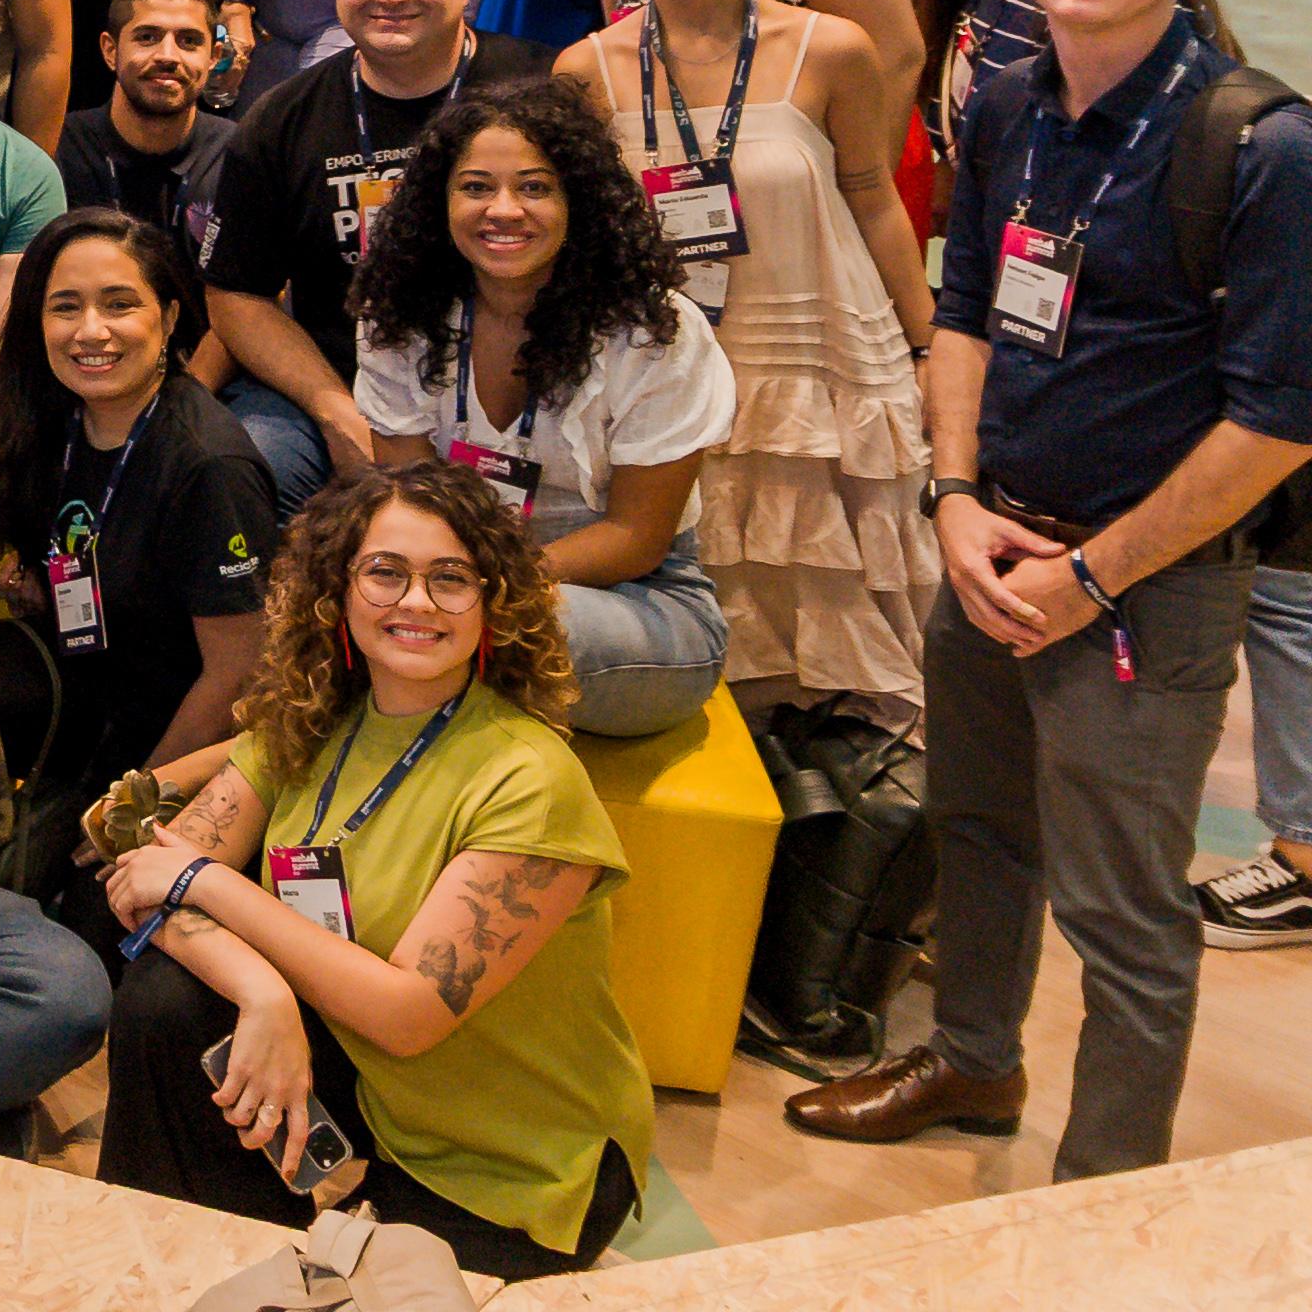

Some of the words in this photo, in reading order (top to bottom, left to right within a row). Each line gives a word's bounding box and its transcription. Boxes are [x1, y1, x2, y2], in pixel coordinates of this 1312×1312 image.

[325, 146, 421, 170] EMPOERING
[676, 240, 728, 257] PARTNER
[67, 633, 95, 648] PARTNER
